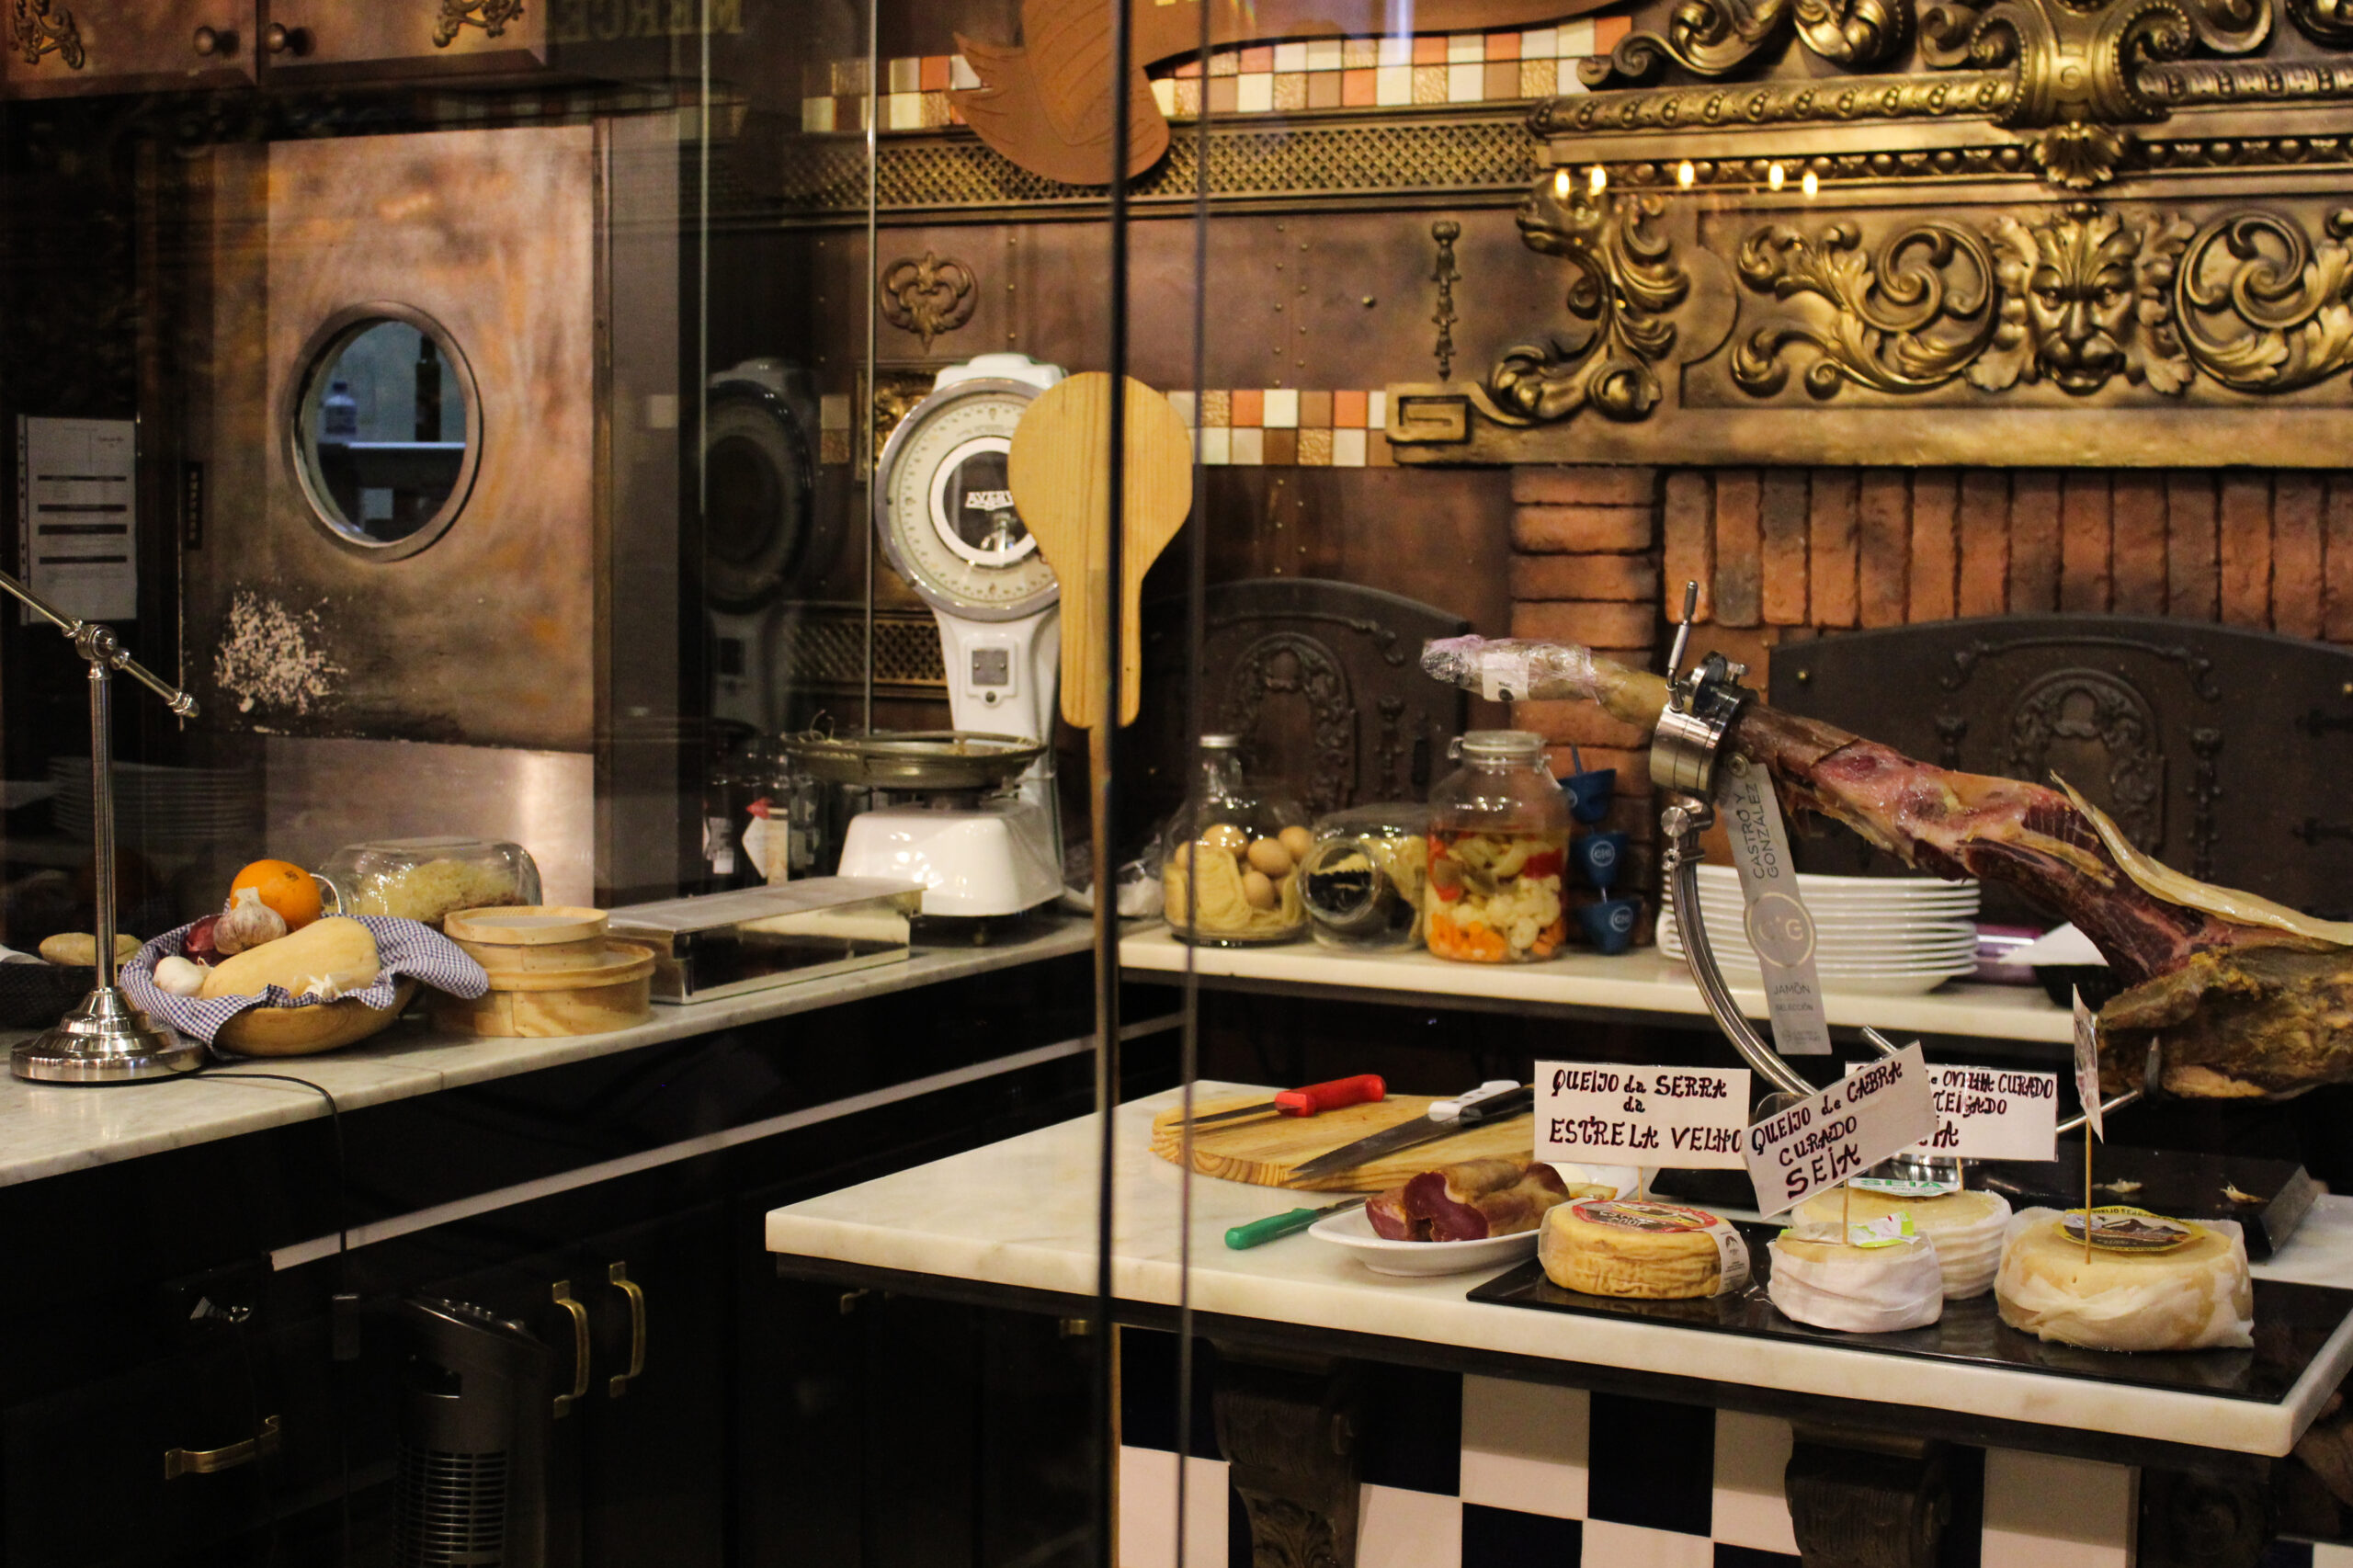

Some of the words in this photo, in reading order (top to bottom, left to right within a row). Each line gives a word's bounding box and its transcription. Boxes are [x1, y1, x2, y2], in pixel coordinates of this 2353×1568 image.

[1734, 793, 1745, 804] Y
[1736, 809, 1765, 879] CASTRO
[1774, 982, 1811, 994] JAMÓN
[1552, 1069, 1620, 1096] QUEIJO
[1624, 1074, 1646, 1094] da
[1654, 1074, 1727, 1098] SERRA
[1997, 1074, 2053, 1098] CURADO
[1623, 1096, 1645, 1113] da
[1751, 1107, 1811, 1156] QUEIJO
[1821, 1095, 1842, 1117] de
[1847, 1061, 1903, 1103] CABRA
[1671, 1127, 1742, 1153] VELHO
[1779, 1116, 1858, 1167] CURADO
[1786, 1143, 1861, 1199] SEIA
